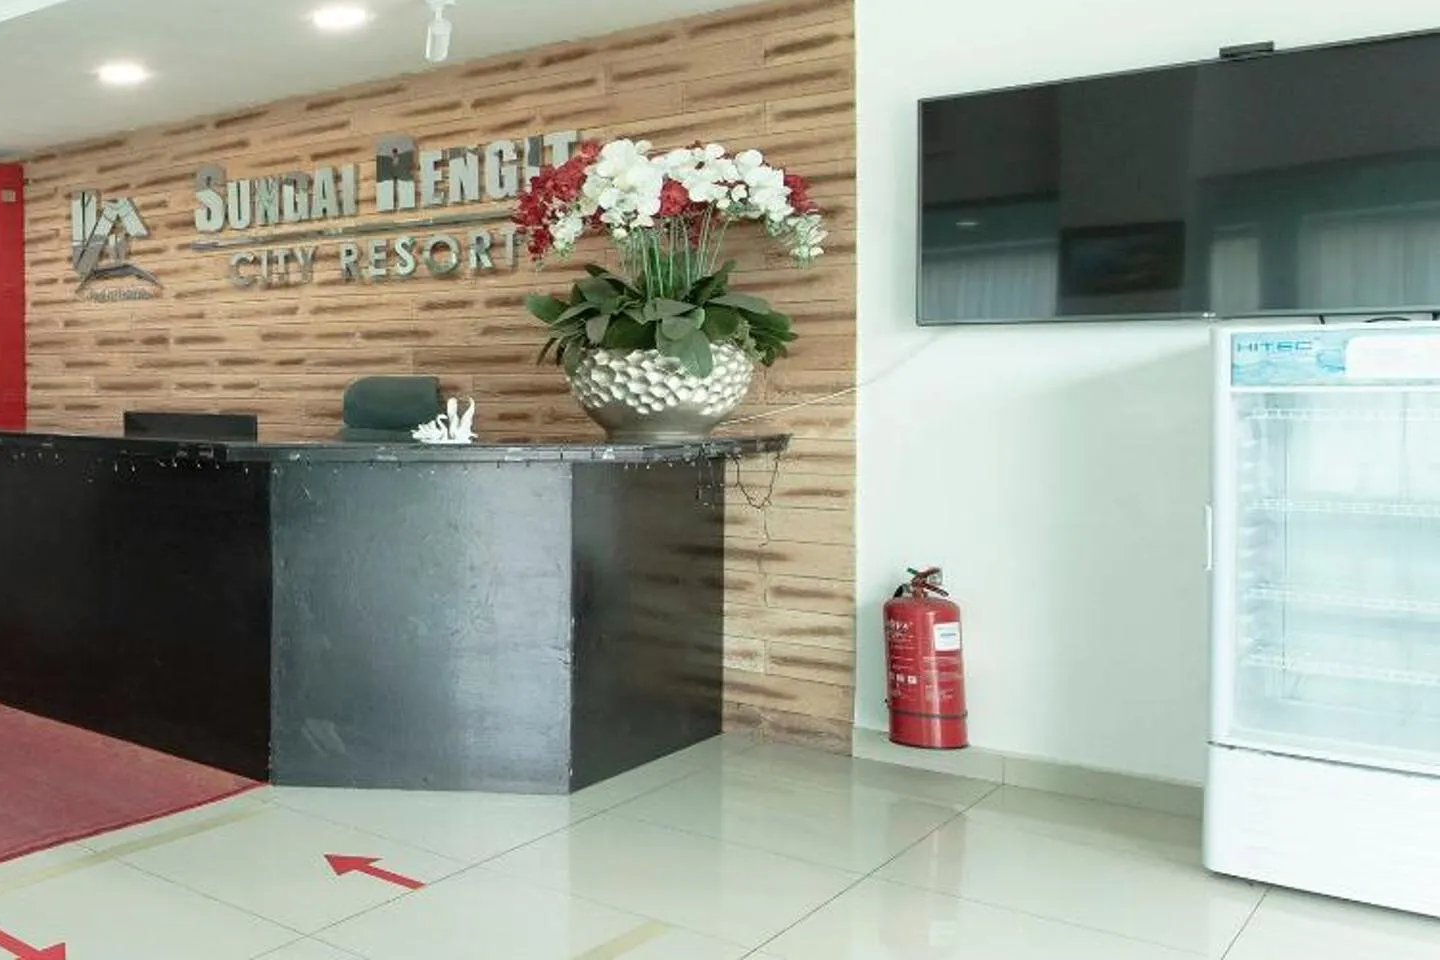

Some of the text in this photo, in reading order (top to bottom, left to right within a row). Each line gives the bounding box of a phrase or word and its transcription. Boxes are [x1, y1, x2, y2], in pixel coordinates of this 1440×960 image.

[194, 161, 358, 232] SUNGAI
[228, 227, 522, 286] CITY RESORT
[1237, 341, 1313, 353] HITEC
